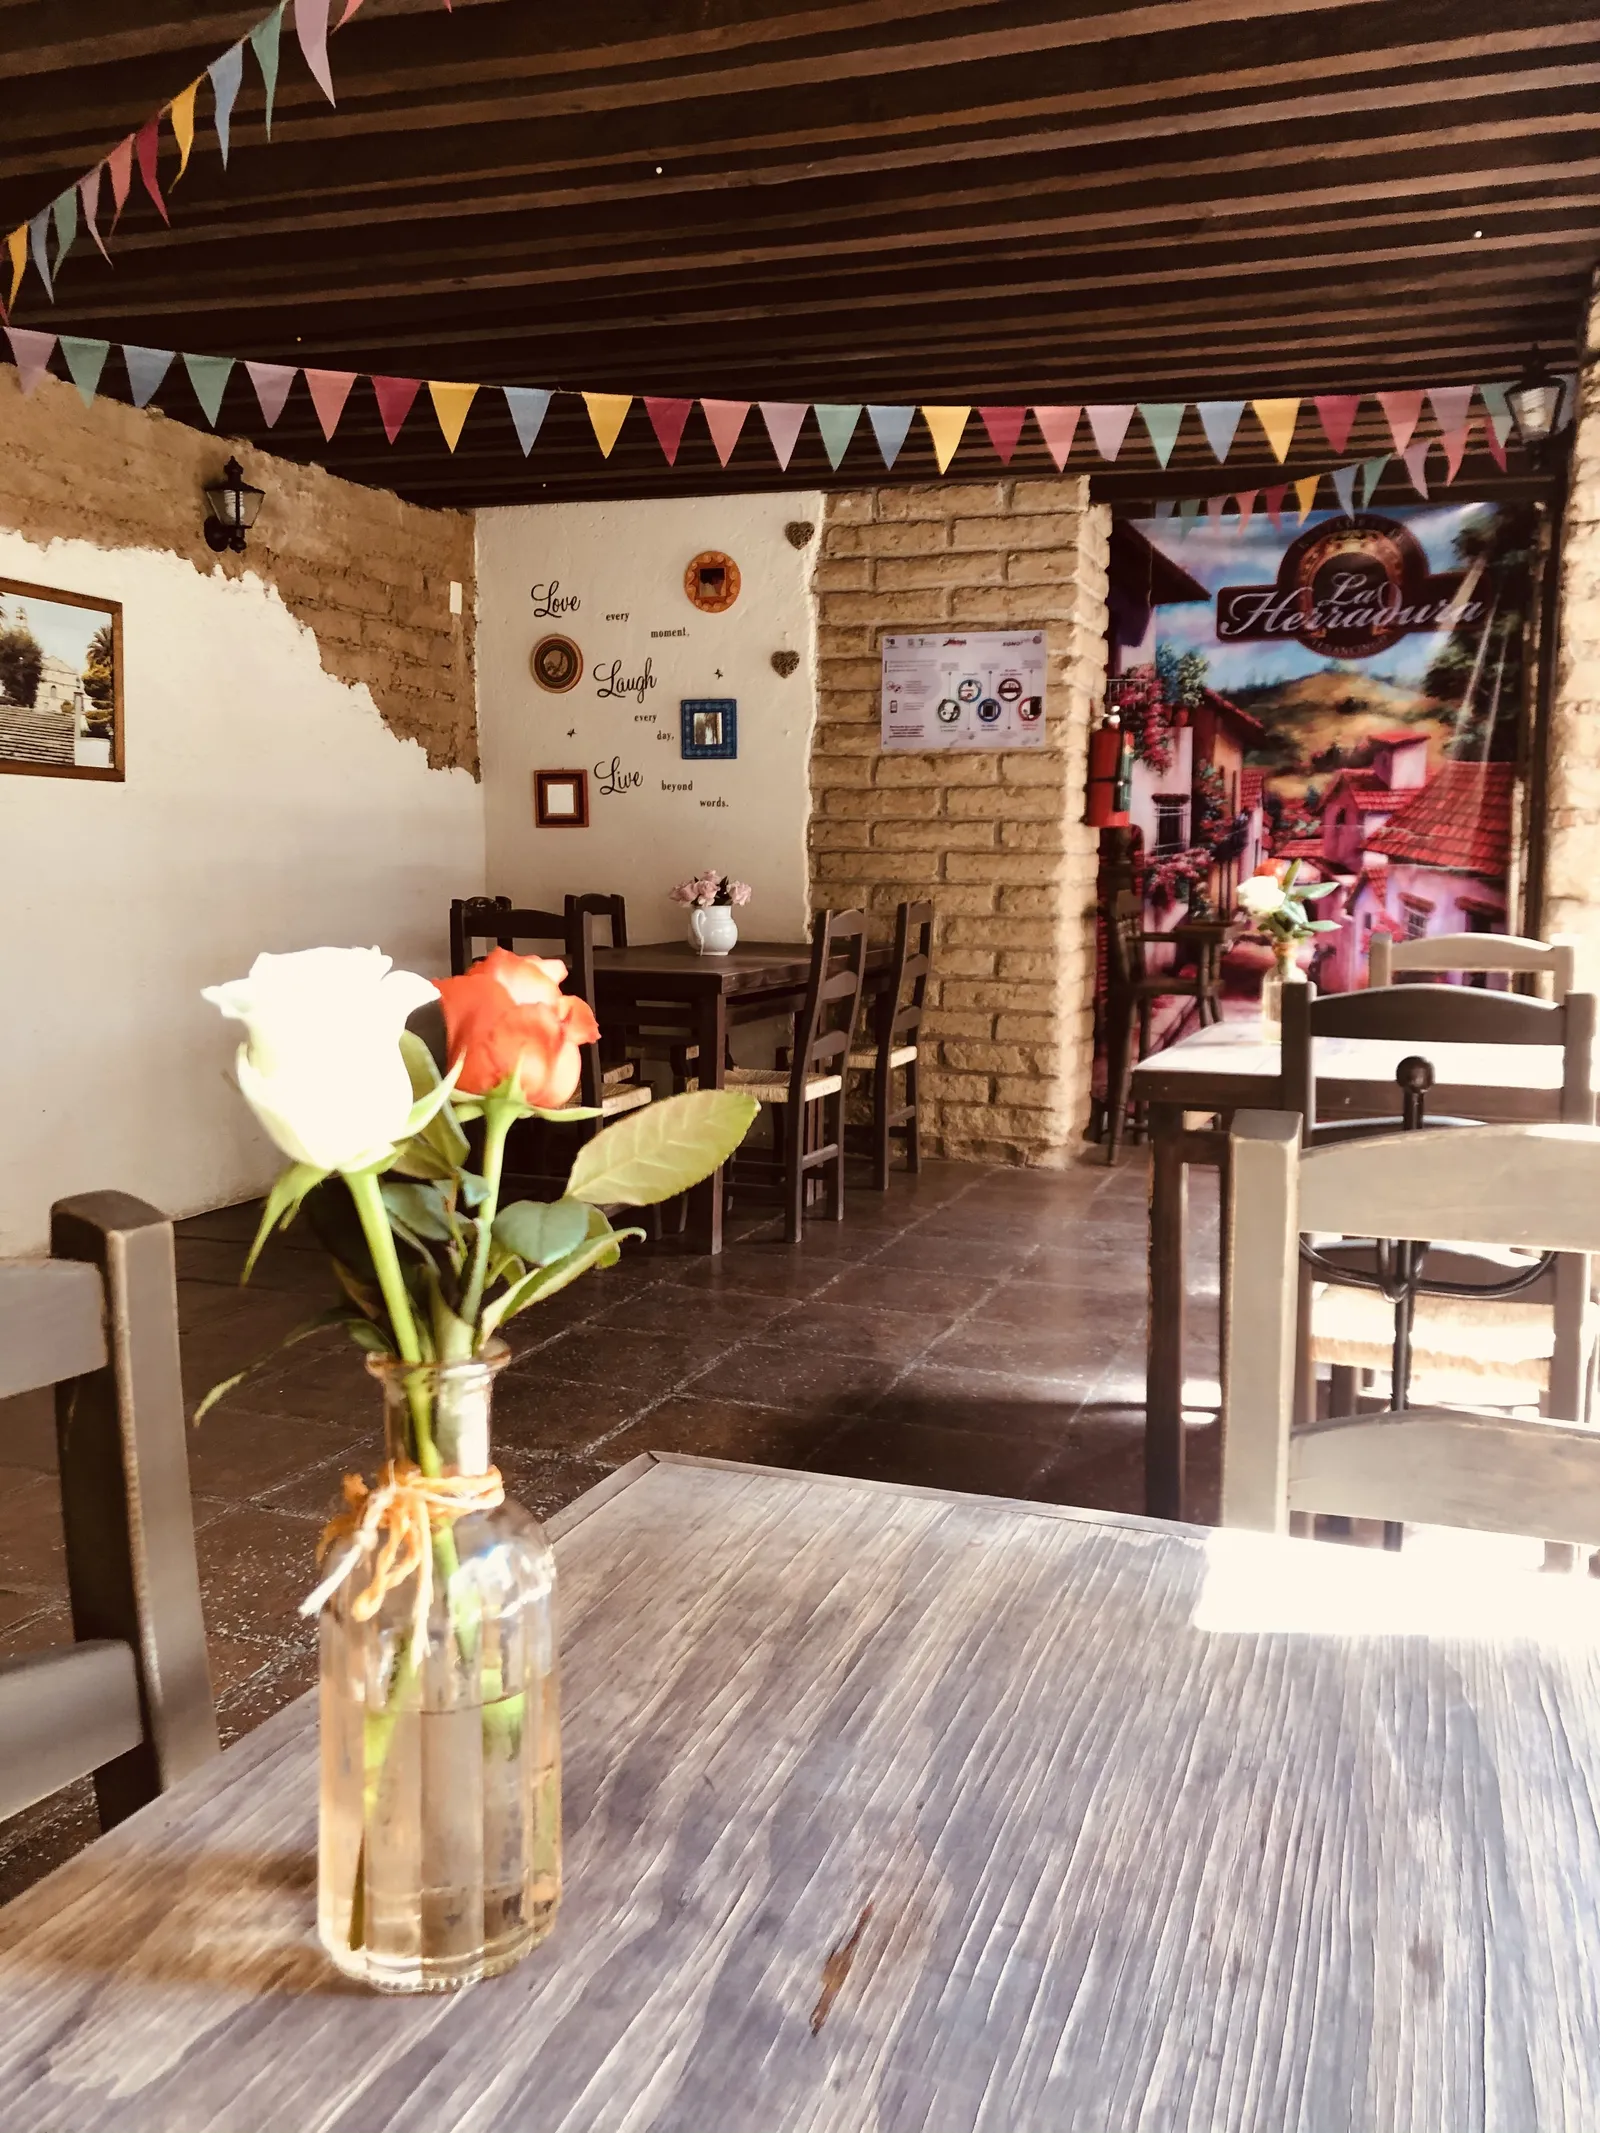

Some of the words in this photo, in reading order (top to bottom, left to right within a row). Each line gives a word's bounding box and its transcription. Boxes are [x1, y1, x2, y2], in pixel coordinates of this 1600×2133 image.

[530, 580, 581, 619] Love
[1318, 572, 1378, 608] La
[605, 611, 630, 623] every
[1220, 583, 1484, 636] Herradura
[592, 657, 658, 704] Laugh
[633, 713, 657, 723] every
[656, 730, 675, 741] day,
[593, 756, 644, 796] Live
[661, 780, 693, 792] beyond
[699, 797, 729, 808] words.
